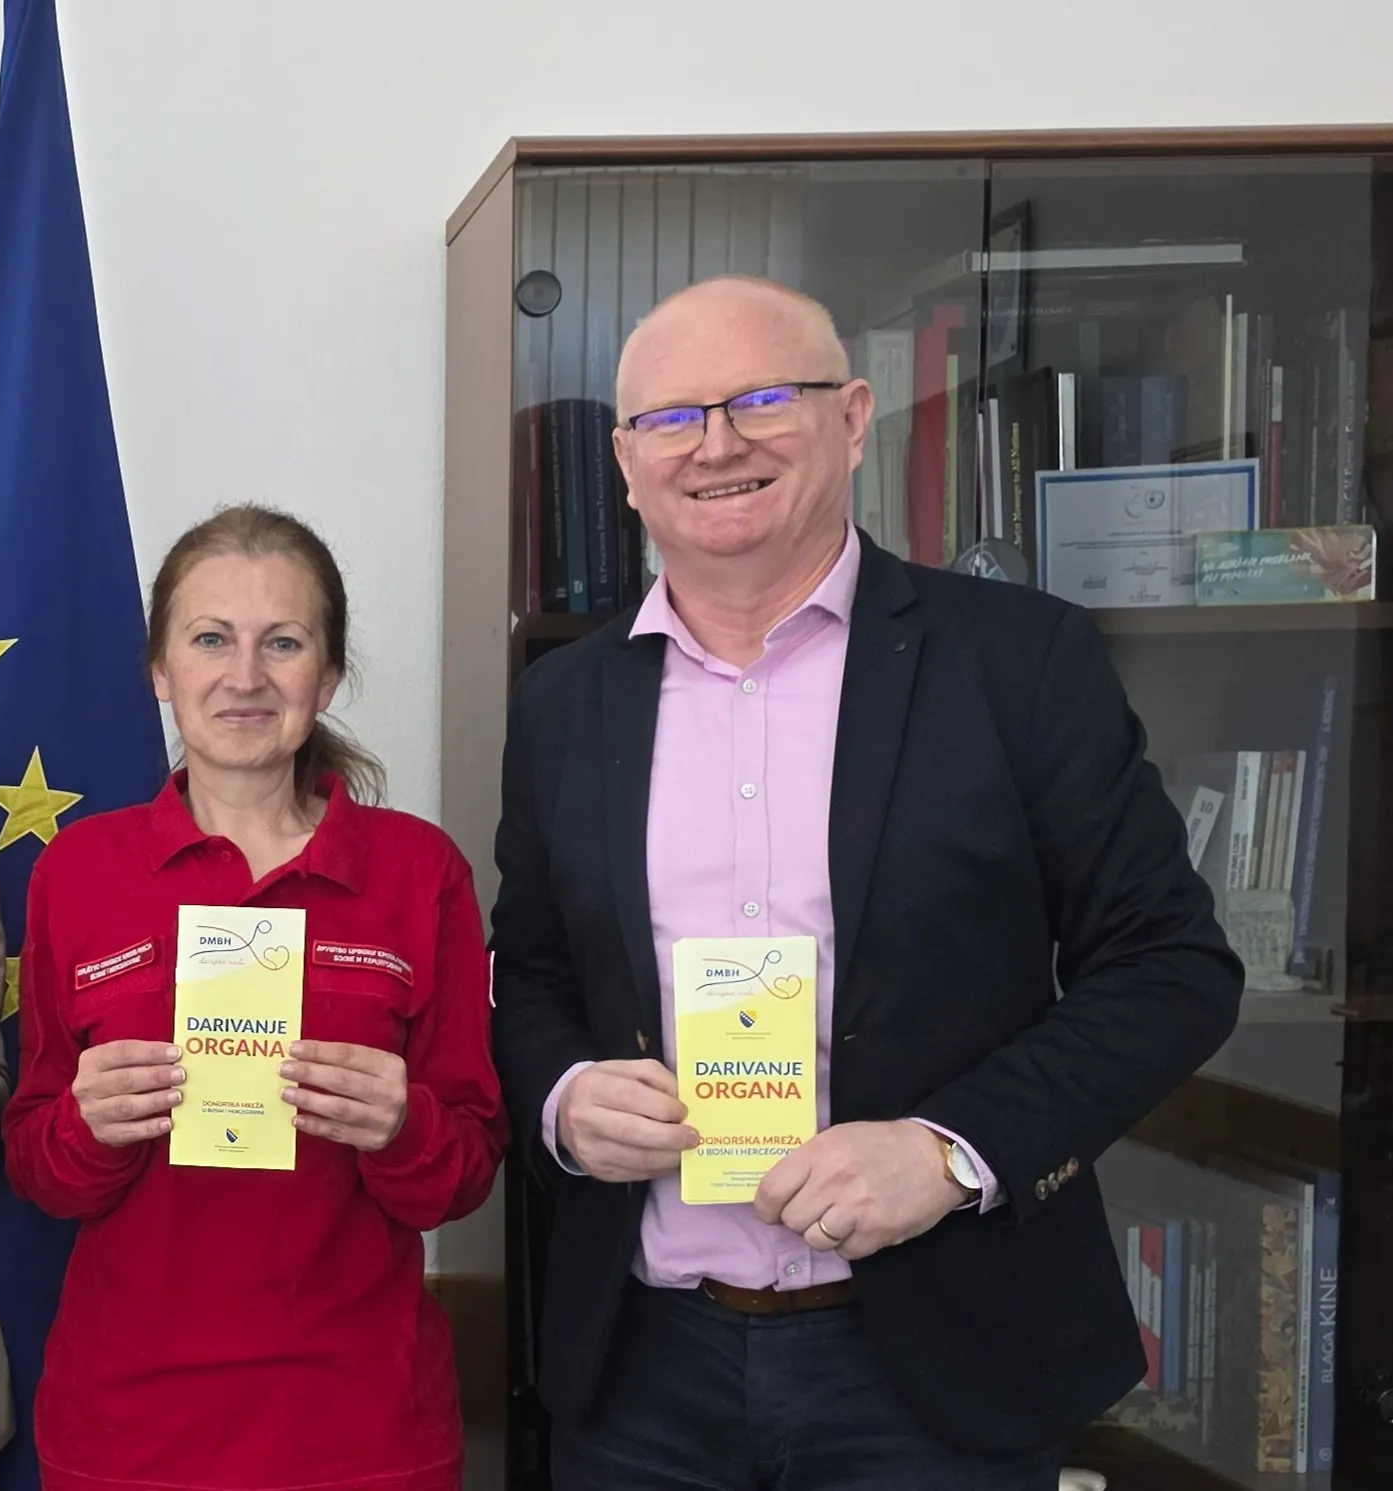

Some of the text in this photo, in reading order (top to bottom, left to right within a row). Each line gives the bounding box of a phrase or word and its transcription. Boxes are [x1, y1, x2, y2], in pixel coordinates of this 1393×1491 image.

[200, 936, 231, 945] DMBH
[706, 969, 740, 977] DMBH
[187, 1017, 287, 1034] DARIVANJE
[185, 1037, 285, 1058] ORGANA
[695, 1061, 803, 1076] DARIVANJE
[695, 1081, 802, 1100] ORGANA
[762, 1134, 802, 1145] MREŽA
[697, 1148, 704, 1156] U
[706, 1148, 734, 1156] BOSNI
[740, 1148, 792, 1156] HERCEGOV
[1320, 1267, 1338, 1384] BLAGA KINE
